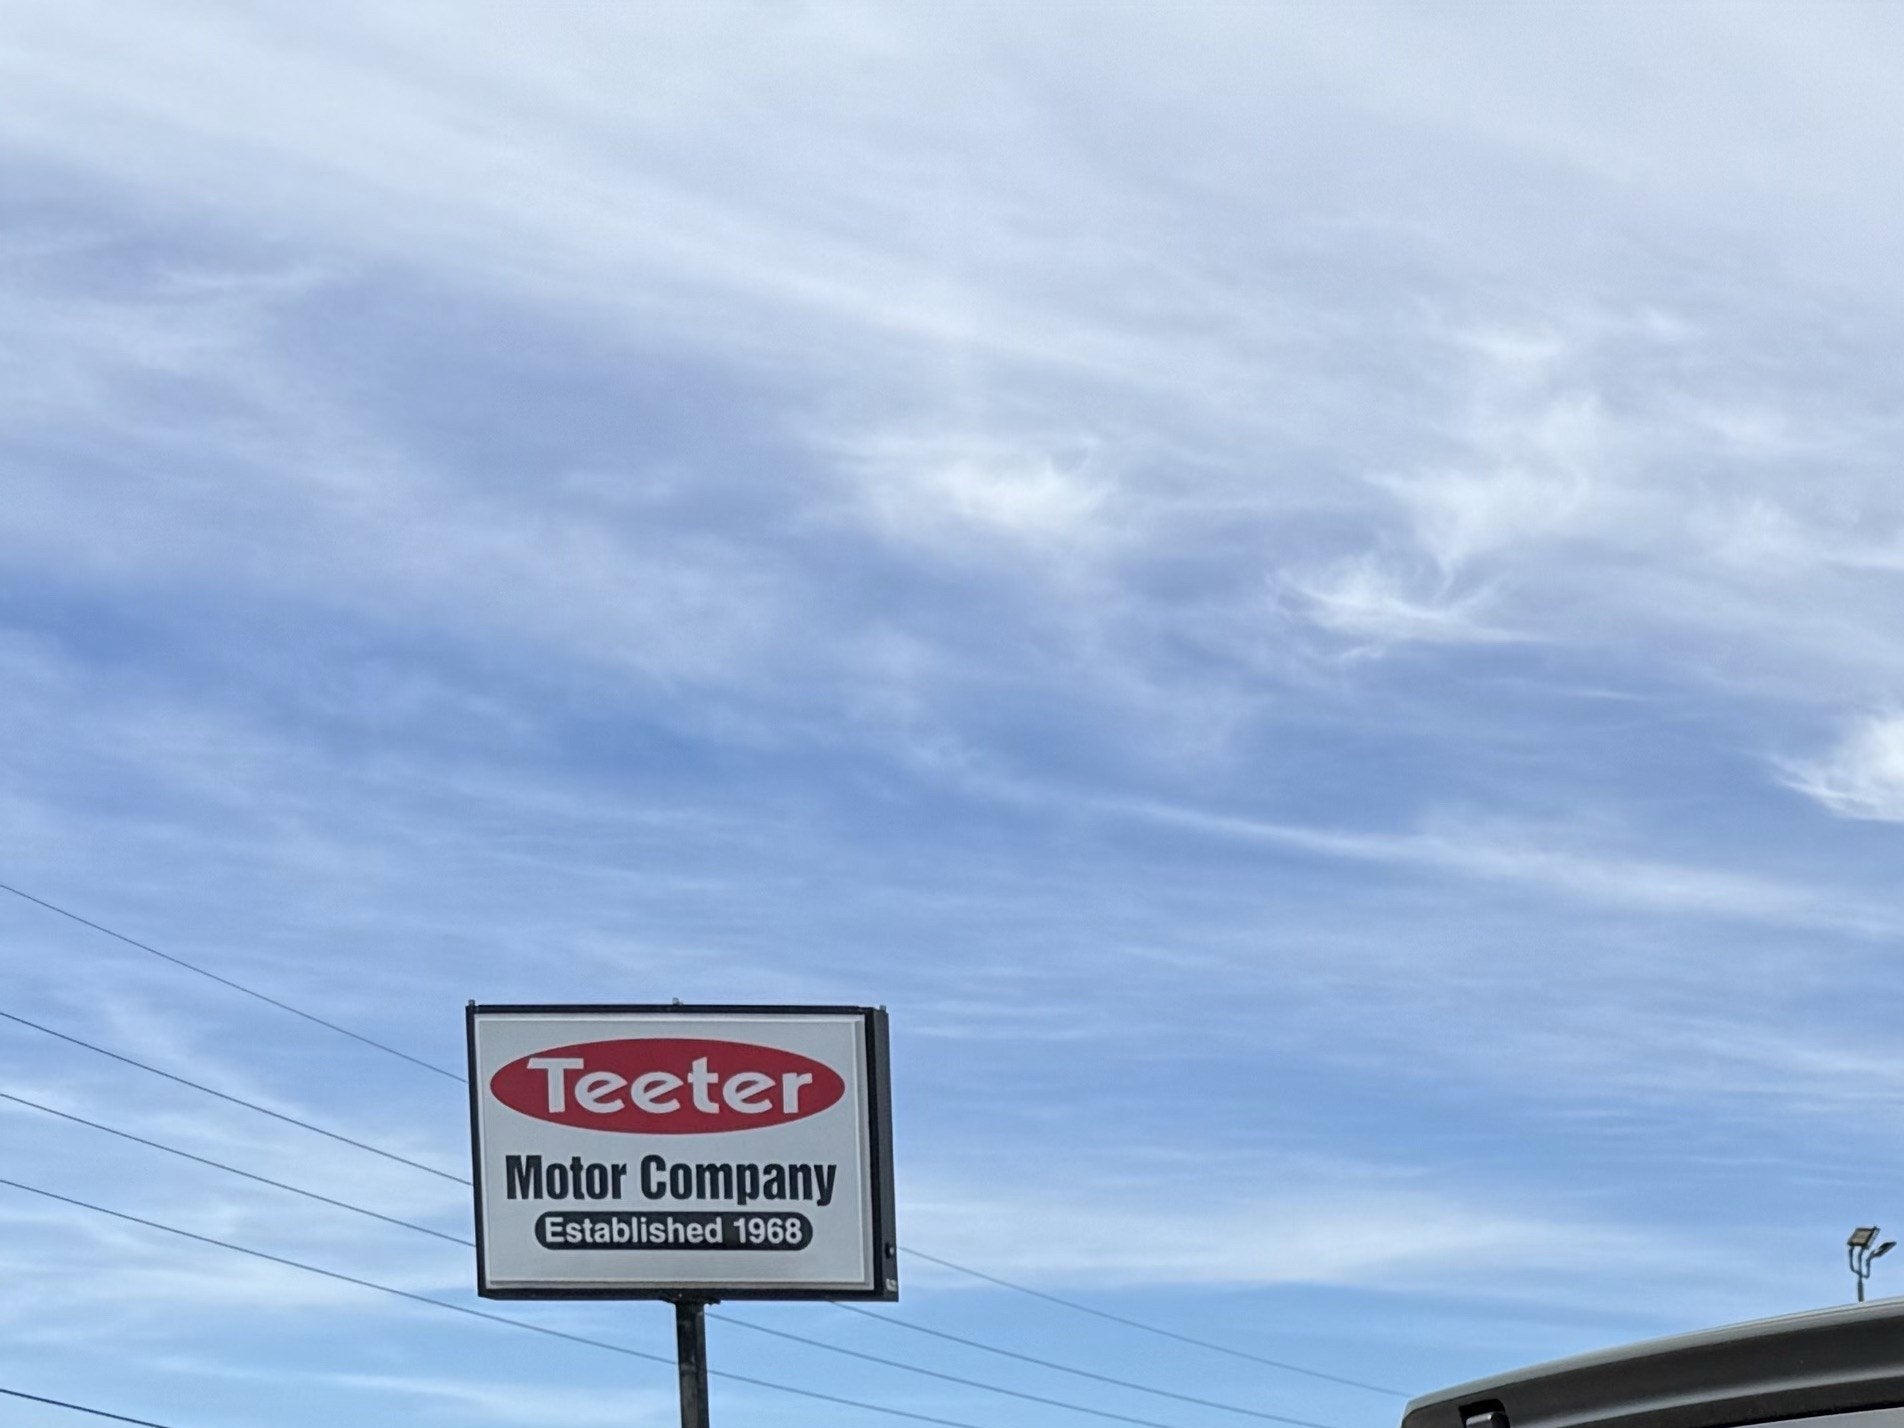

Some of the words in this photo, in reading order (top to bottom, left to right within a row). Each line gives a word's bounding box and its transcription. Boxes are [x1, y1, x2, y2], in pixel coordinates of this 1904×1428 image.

[527, 1057, 812, 1114] Teeter
[505, 1154, 627, 1201] Motor
[640, 1154, 837, 1207] Company
[545, 1216, 724, 1244] Established
[732, 1217, 803, 1245] 1968
